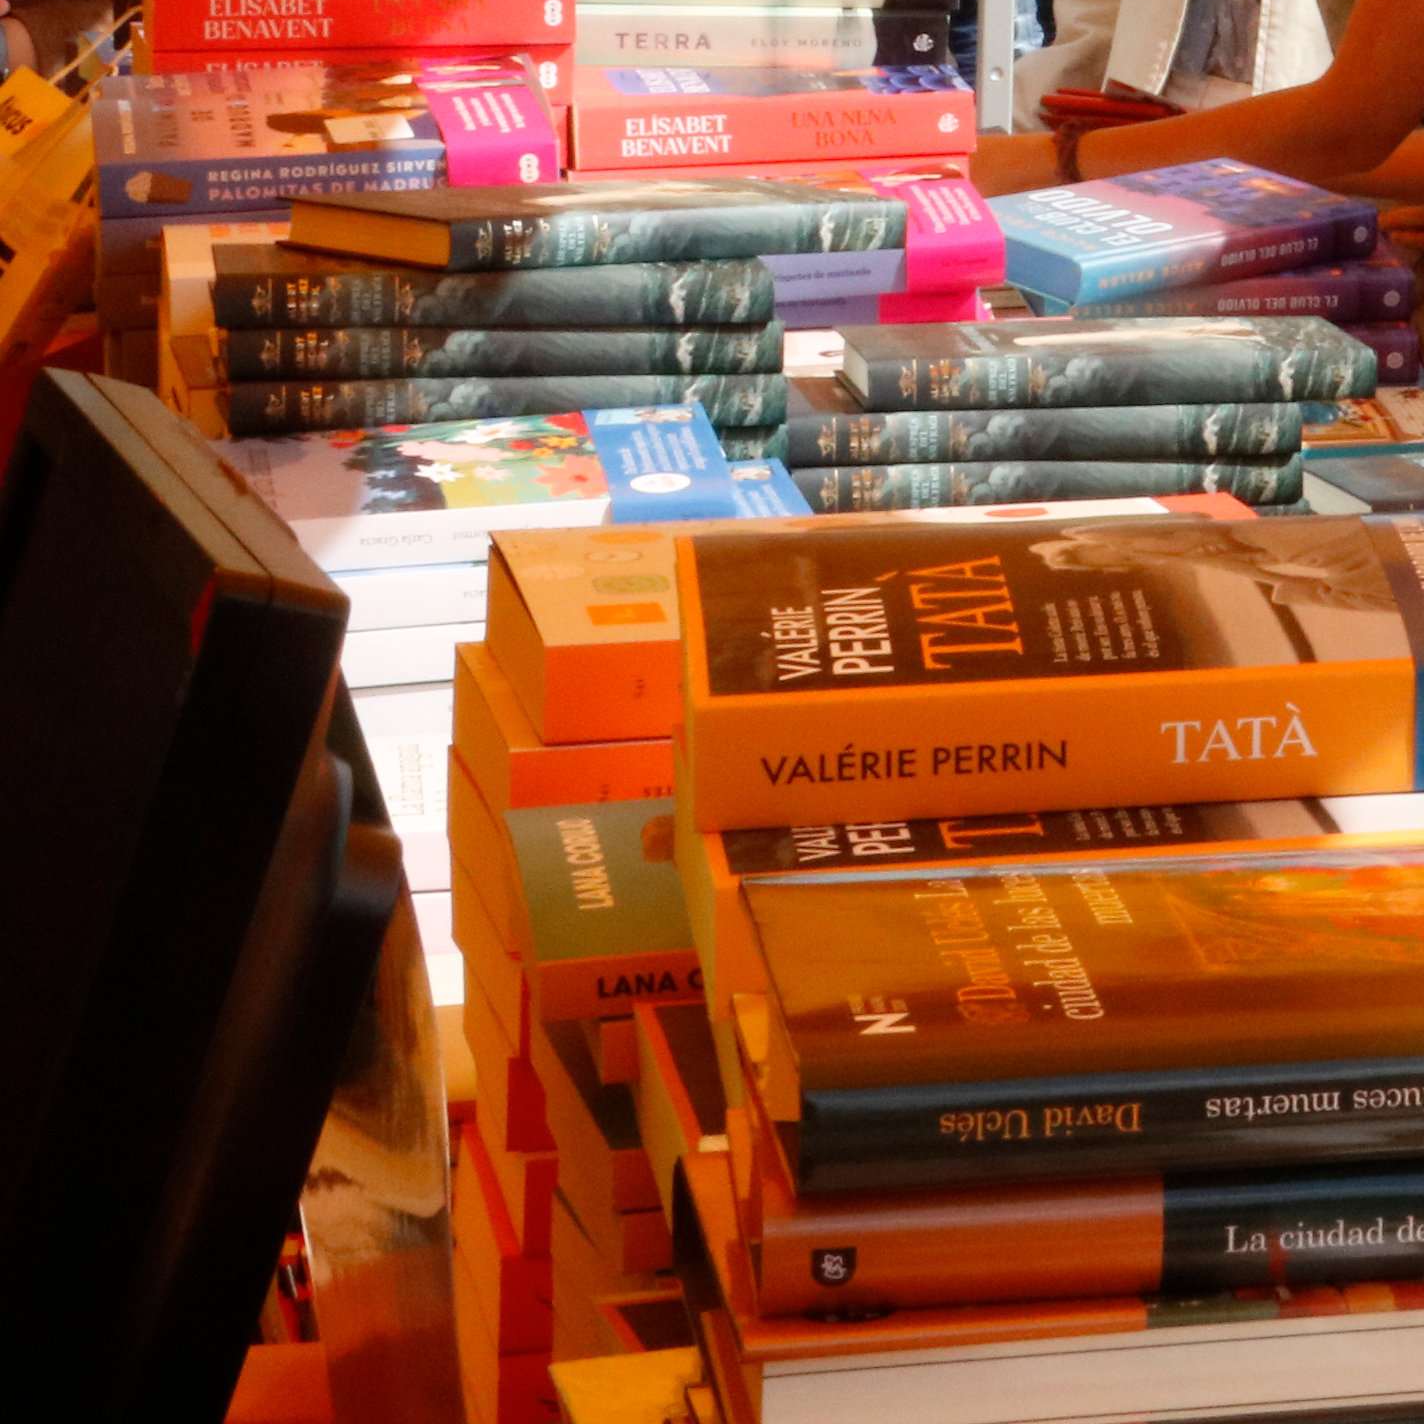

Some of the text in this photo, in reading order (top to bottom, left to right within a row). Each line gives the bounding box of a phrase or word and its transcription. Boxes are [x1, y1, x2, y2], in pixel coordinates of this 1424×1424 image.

[203, 17, 334, 40] BENAVENT
[615, 32, 712, 51] TERRA
[791, 107, 897, 129] UNA NENA
[621, 134, 733, 157] BENAVENT
[815, 128, 875, 149] BONA
[207, 158, 449, 183] REGINA RODRÍGUEZ SIRVEN
[207, 177, 449, 201] PALOMITAS DE MADRUG
[1028, 189, 1174, 235] OLVIDO
[1033, 210, 1109, 235] CLUB
[1100, 231, 1142, 247] EL
[1280, 239, 1305, 257] CLUB
[1220, 248, 1257, 267] OLVIDO
[1258, 244, 1278, 260] DEL
[1217, 297, 1260, 312] OLVIDO
[1265, 296, 1287, 310] DEL
[1290, 295, 1321, 310] CLUB
[1324, 294, 1339, 307] EL
[359, 536, 399, 549] Gracia
[767, 604, 824, 682] VALÉRIE
[821, 586, 895, 676] PERRIN
[760, 702, 1319, 787] VALÉRIE PERRIN TATÀ
[571, 865, 615, 910] LANA
[1006, 907, 1063, 932] las
[1016, 935, 1073, 954] de
[597, 970, 678, 999] LANA
[938, 947, 1017, 1004] David
[1023, 957, 1105, 1020] ciudad
[1205, 1090, 1341, 1121] muertas
[939, 1102, 1029, 1140] Uclés
[1042, 1101, 1141, 1136] David
[1225, 1224, 1267, 1254] La
[1279, 1216, 1384, 1249] ciudad
